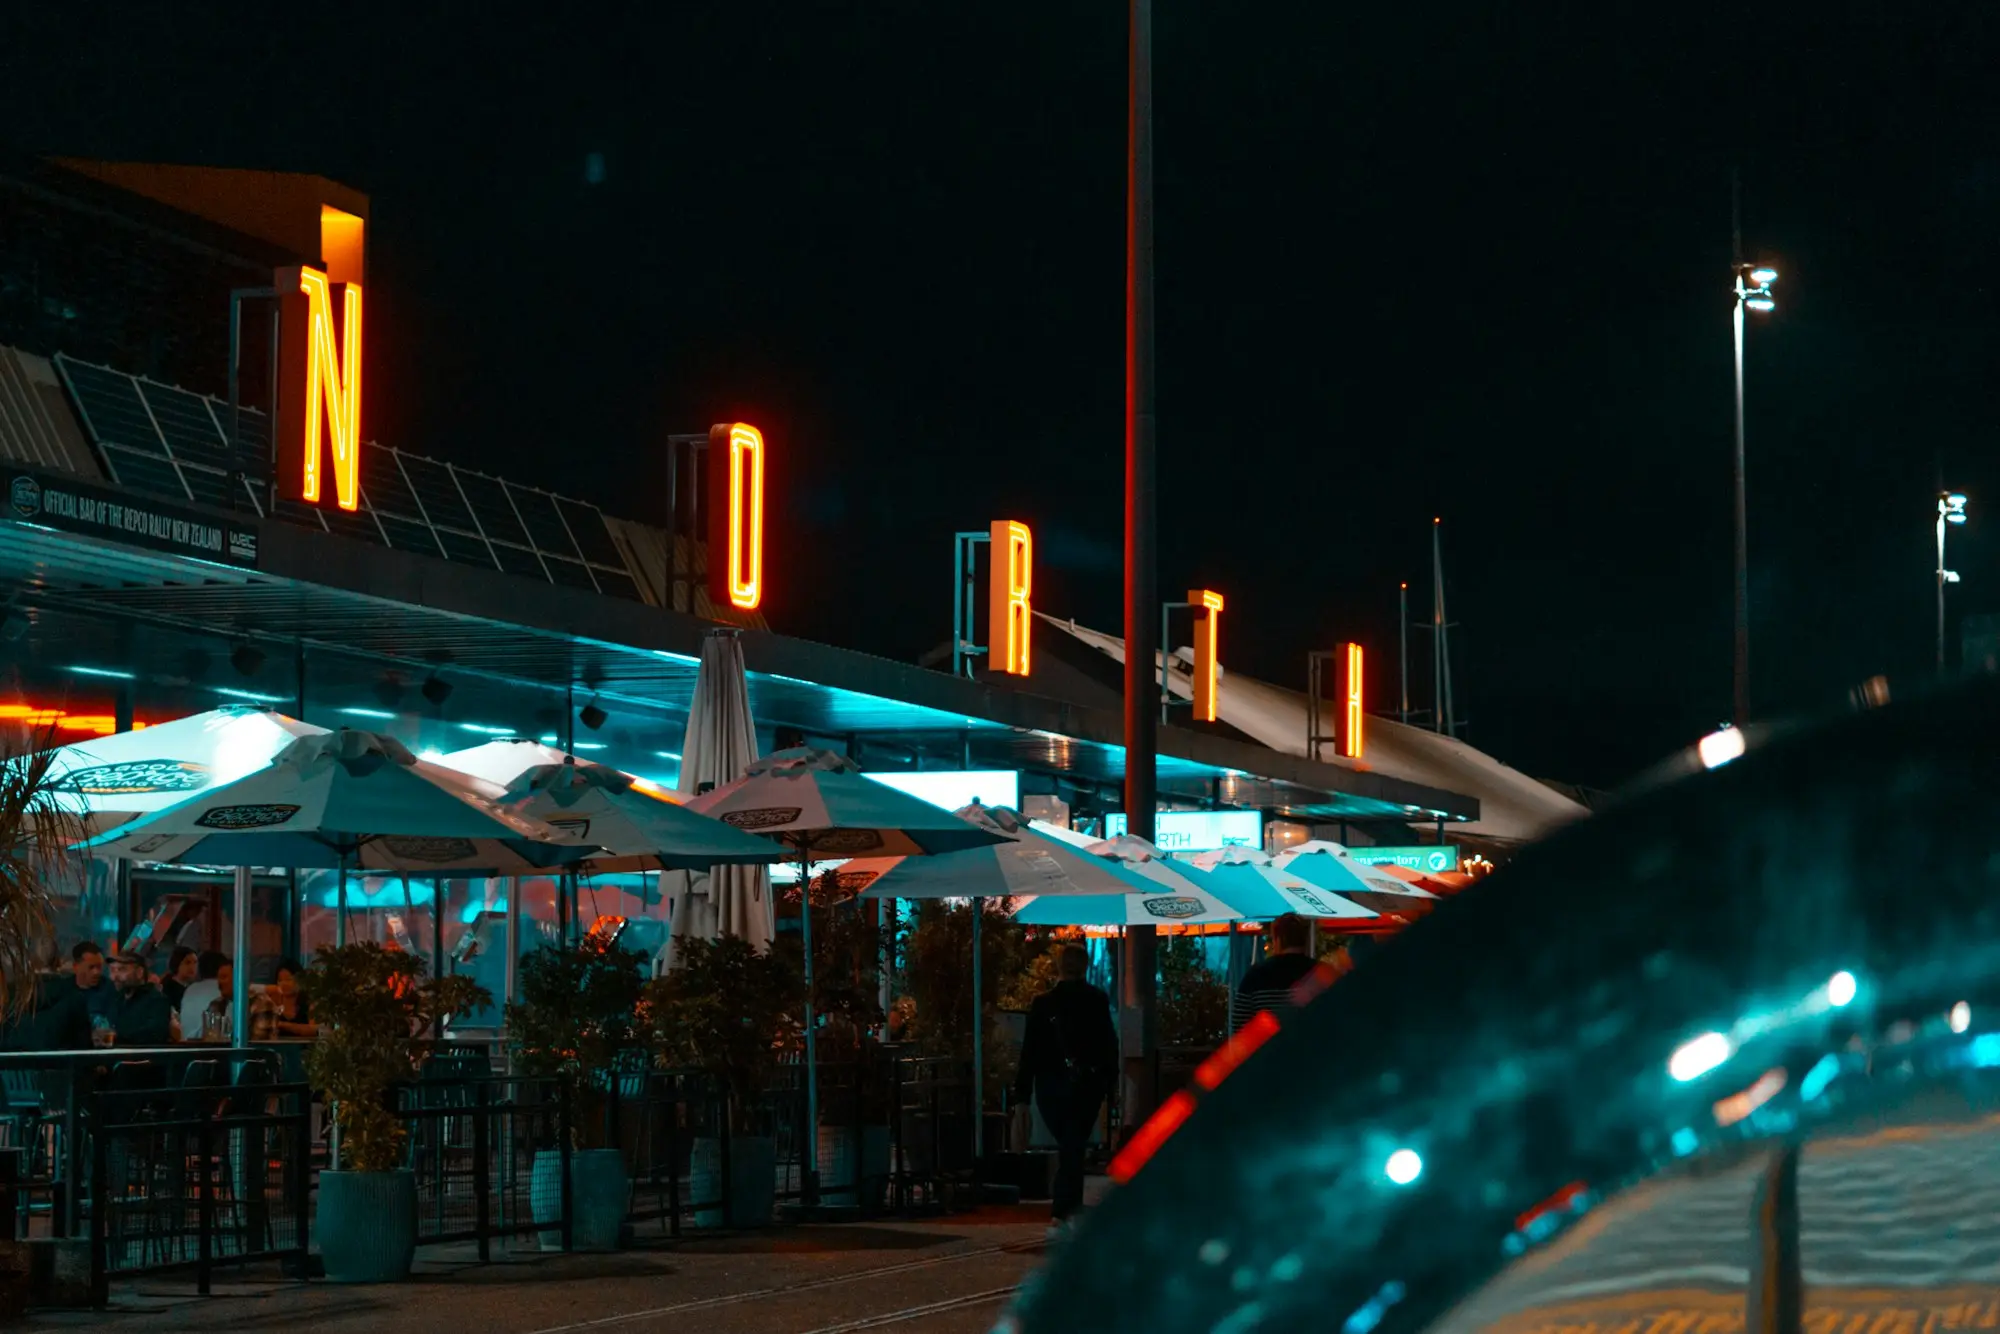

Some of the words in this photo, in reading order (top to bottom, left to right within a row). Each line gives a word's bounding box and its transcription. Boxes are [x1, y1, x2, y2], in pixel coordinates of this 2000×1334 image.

[44, 489, 78, 519] OFFICIAL
[79, 496, 95, 522] BAR
[96, 500, 107, 525] OF
[108, 503, 123, 529] THE
[124, 506, 148, 535] REPCO
[148, 513, 172, 540] RALLY
[172, 518, 190, 544] NEW
[190, 522, 222, 552] ZEALAND
[114, 763, 181, 772] GOOD
